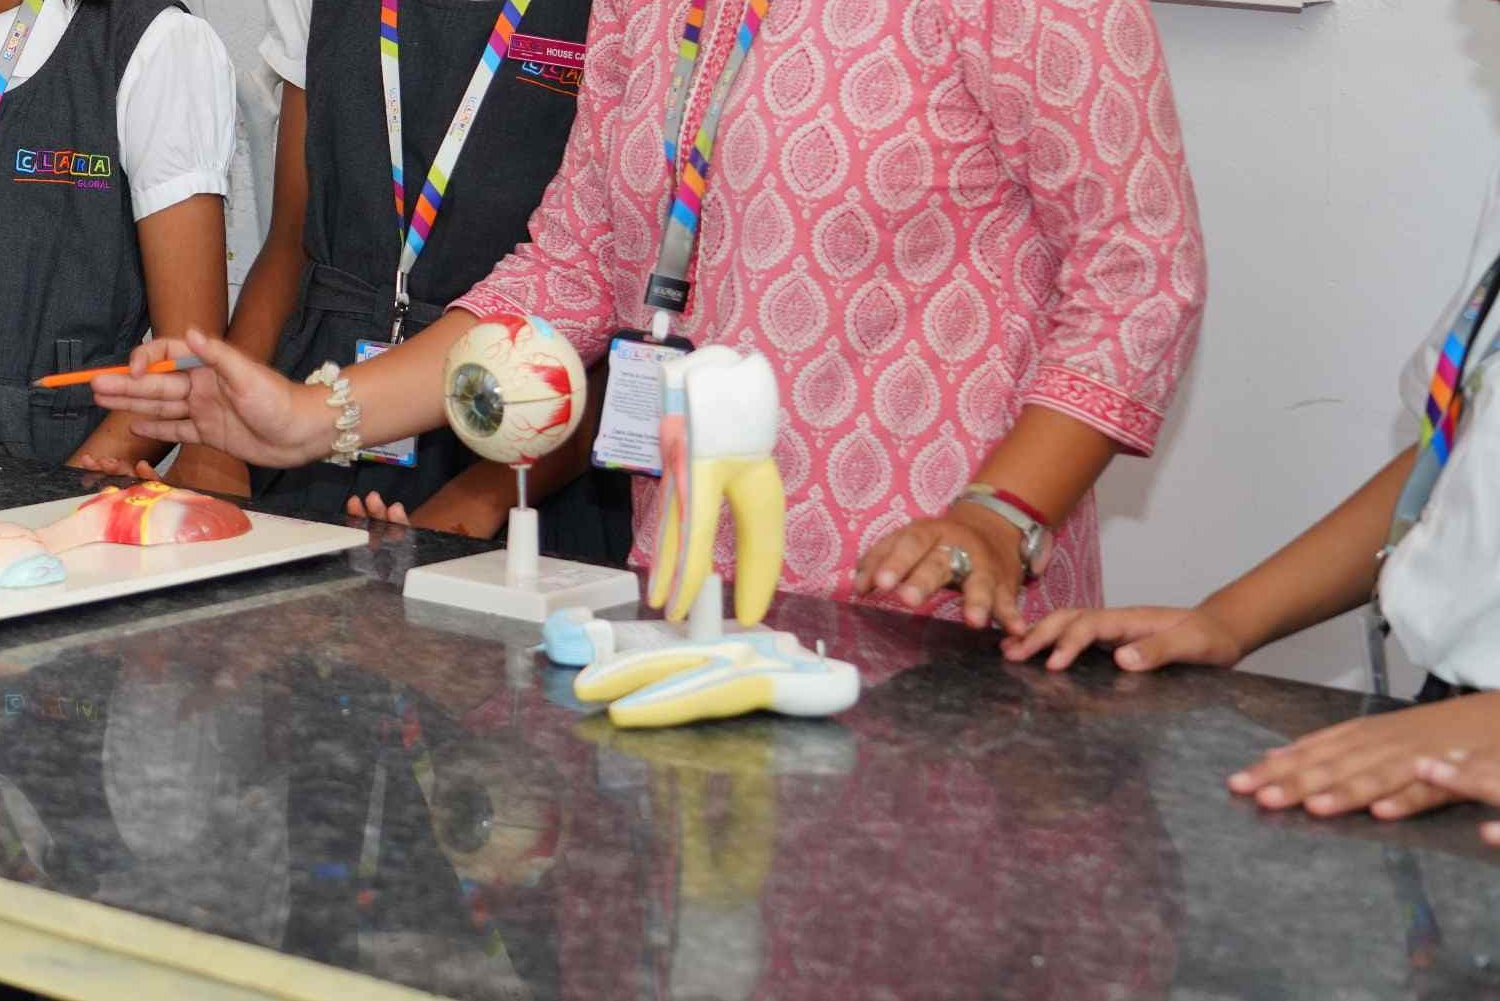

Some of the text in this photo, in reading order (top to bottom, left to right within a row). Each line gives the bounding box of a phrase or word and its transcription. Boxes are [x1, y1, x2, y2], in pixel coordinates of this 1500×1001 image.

[546, 47, 573, 59] HOUSE
[17, 150, 109, 175] CLARA
[77, 179, 109, 189] GLOBAL
